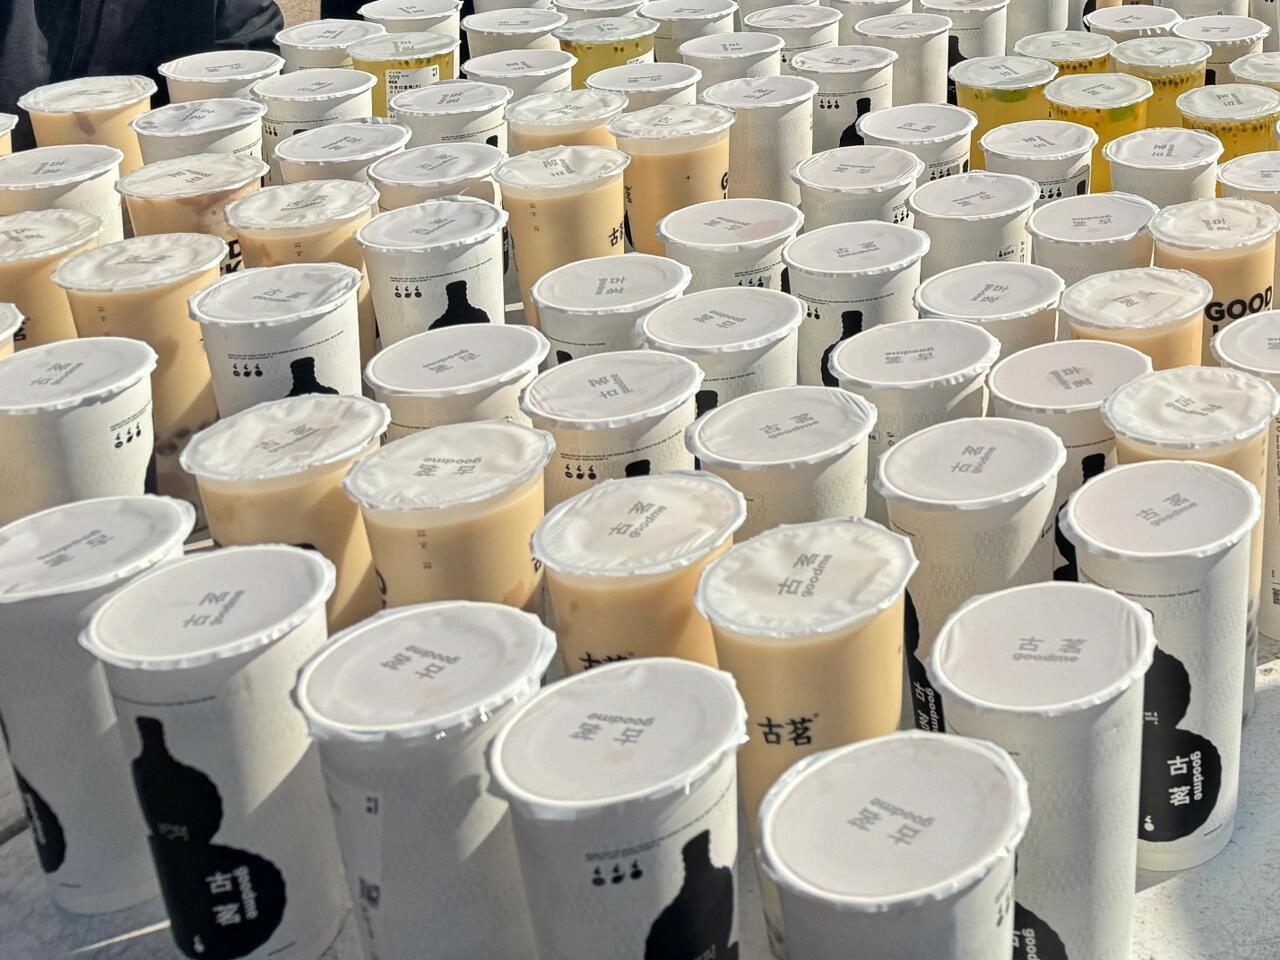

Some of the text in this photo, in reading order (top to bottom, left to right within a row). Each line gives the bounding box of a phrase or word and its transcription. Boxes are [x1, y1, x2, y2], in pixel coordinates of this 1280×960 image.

[1204, 285, 1273, 322] GOOD
[608, 501, 655, 537] 古茗
[778, 553, 820, 596] 古茗
[801, 553, 833, 598] goodme
[1011, 651, 1080, 664] goodme
[1018, 637, 1087, 654] 古茗
[381, 651, 446, 681] 古茗
[568, 722, 645, 746] 古茗
[587, 712, 656, 727] goodme
[758, 716, 814, 746] 古茗
[1167, 756, 1190, 806] 古茗
[1190, 750, 1203, 801] goodme
[847, 807, 921, 846] 古茗
[869, 797, 936, 827] goodme
